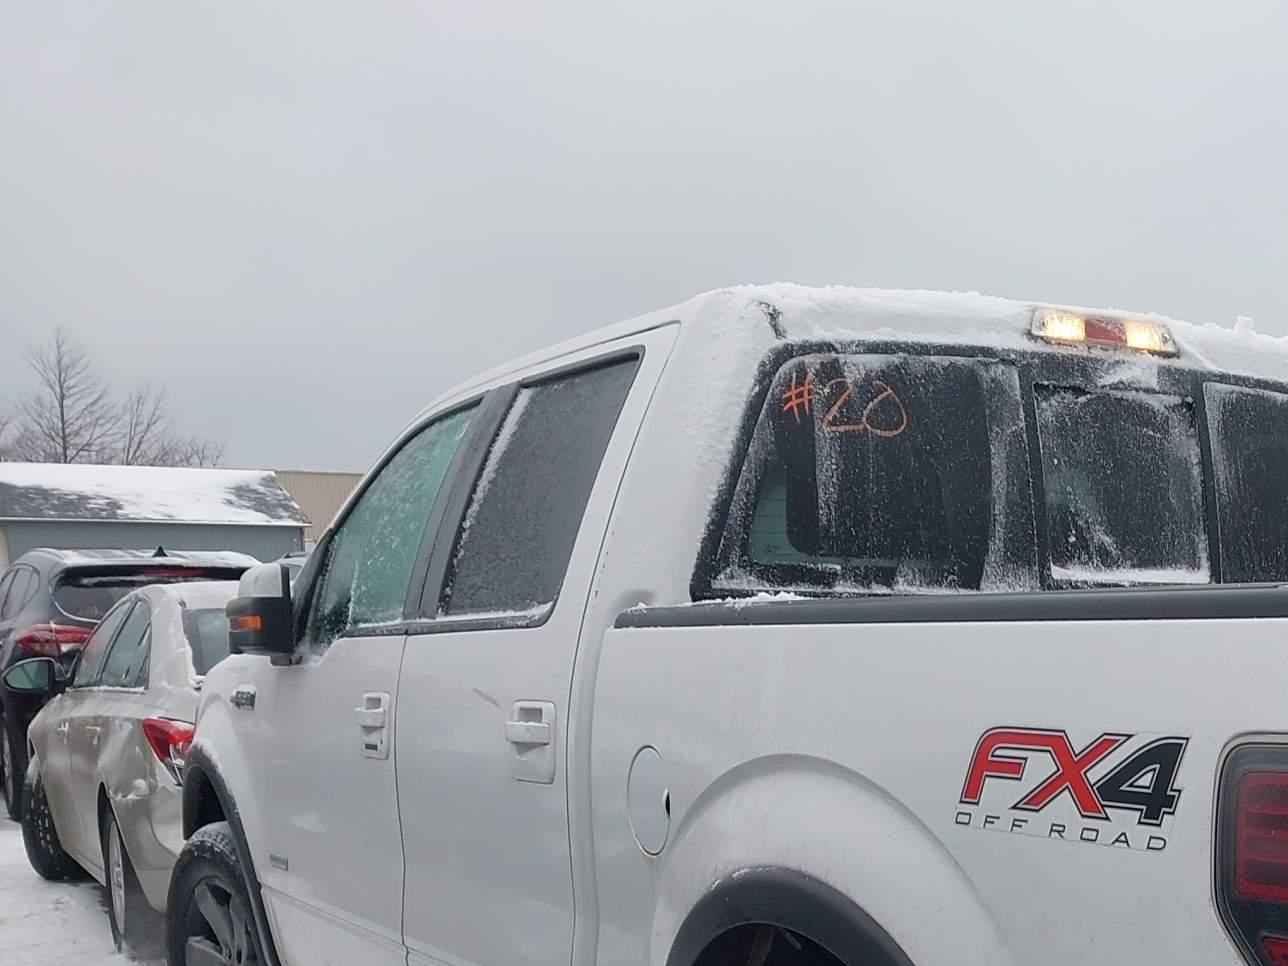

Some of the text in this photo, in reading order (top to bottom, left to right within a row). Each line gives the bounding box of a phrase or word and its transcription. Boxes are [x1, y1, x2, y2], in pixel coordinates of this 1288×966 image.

[782, 367, 908, 437] #20
[959, 726, 1191, 827] FX4
[954, 811, 1167, 851] OFF ROAD
